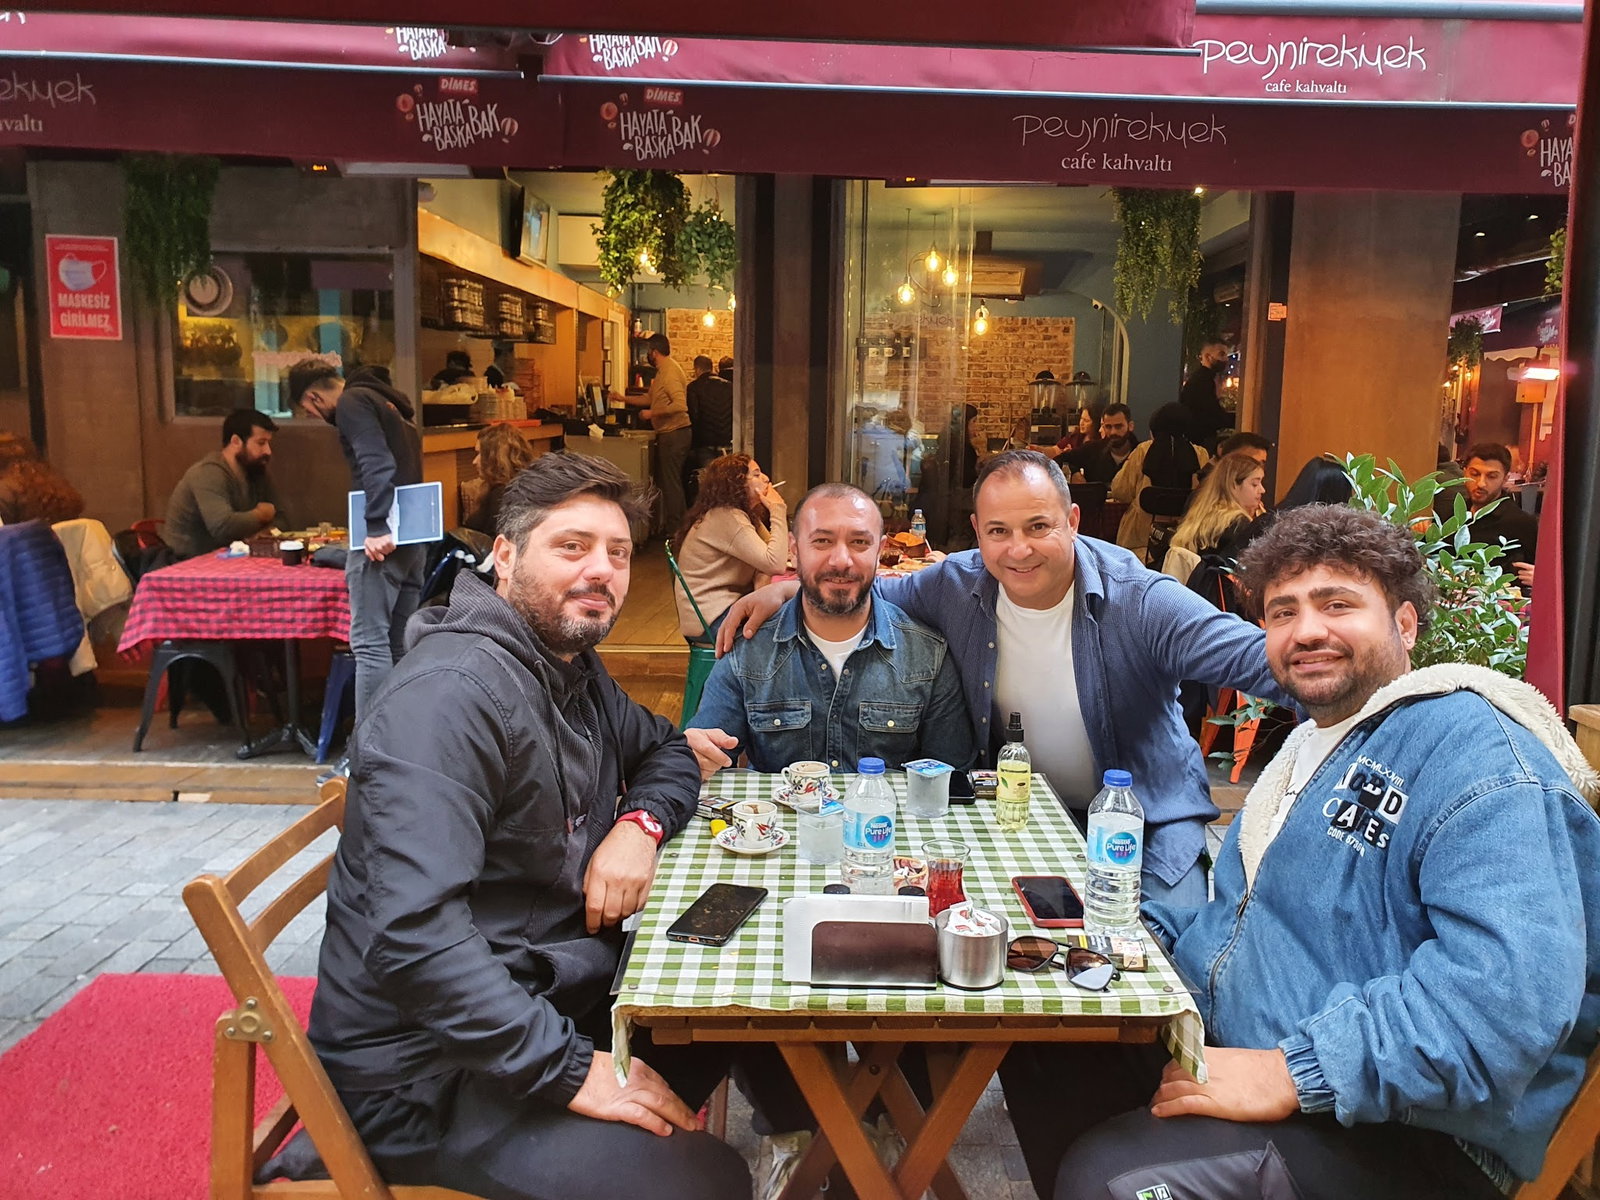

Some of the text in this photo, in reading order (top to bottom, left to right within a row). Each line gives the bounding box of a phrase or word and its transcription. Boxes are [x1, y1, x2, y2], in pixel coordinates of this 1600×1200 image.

[1265, 79, 1347, 94] cafe kahvaltı
[0, 113, 43, 132] valtı
[416, 99, 500, 139] HAYATA BAK
[620, 109, 702, 150] HAYATA BAK
[1061, 153, 1172, 171] cafe kahvaltı
[58, 292, 110, 310] MASKESİZ
[60, 310, 110, 328] GİRİLMEZ
[1107, 842, 1124, 852] Pure
